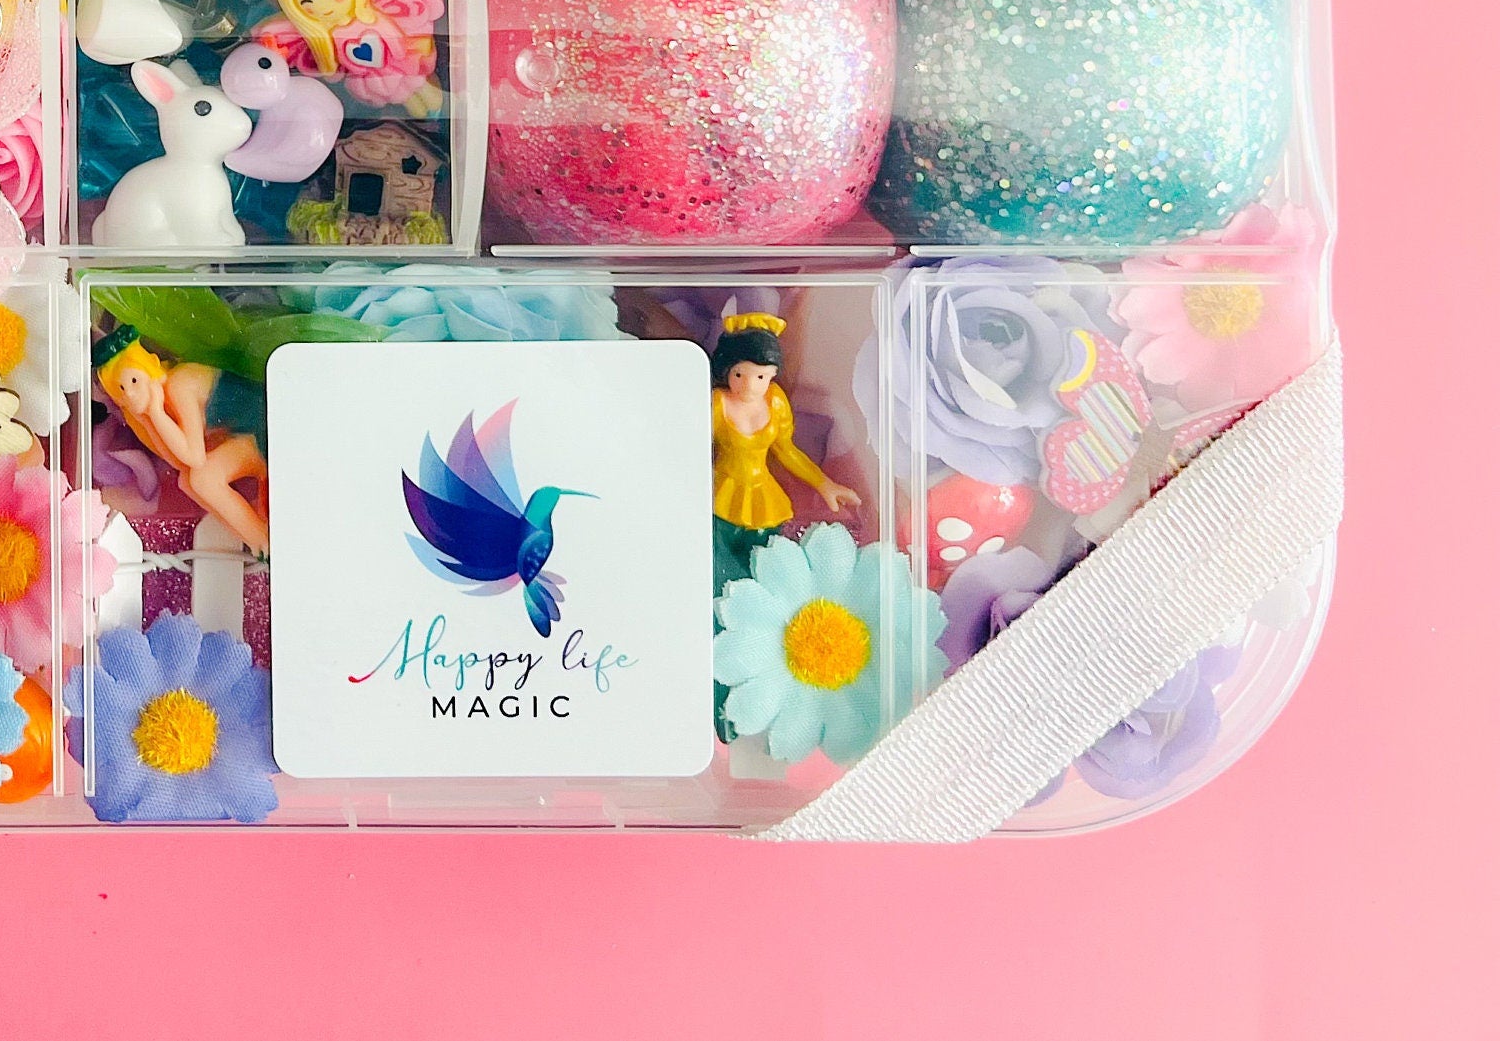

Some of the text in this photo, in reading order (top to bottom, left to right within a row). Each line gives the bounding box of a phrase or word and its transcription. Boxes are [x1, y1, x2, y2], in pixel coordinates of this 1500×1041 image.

[347, 614, 639, 694] Happy life
[431, 695, 571, 719] MAGIC
